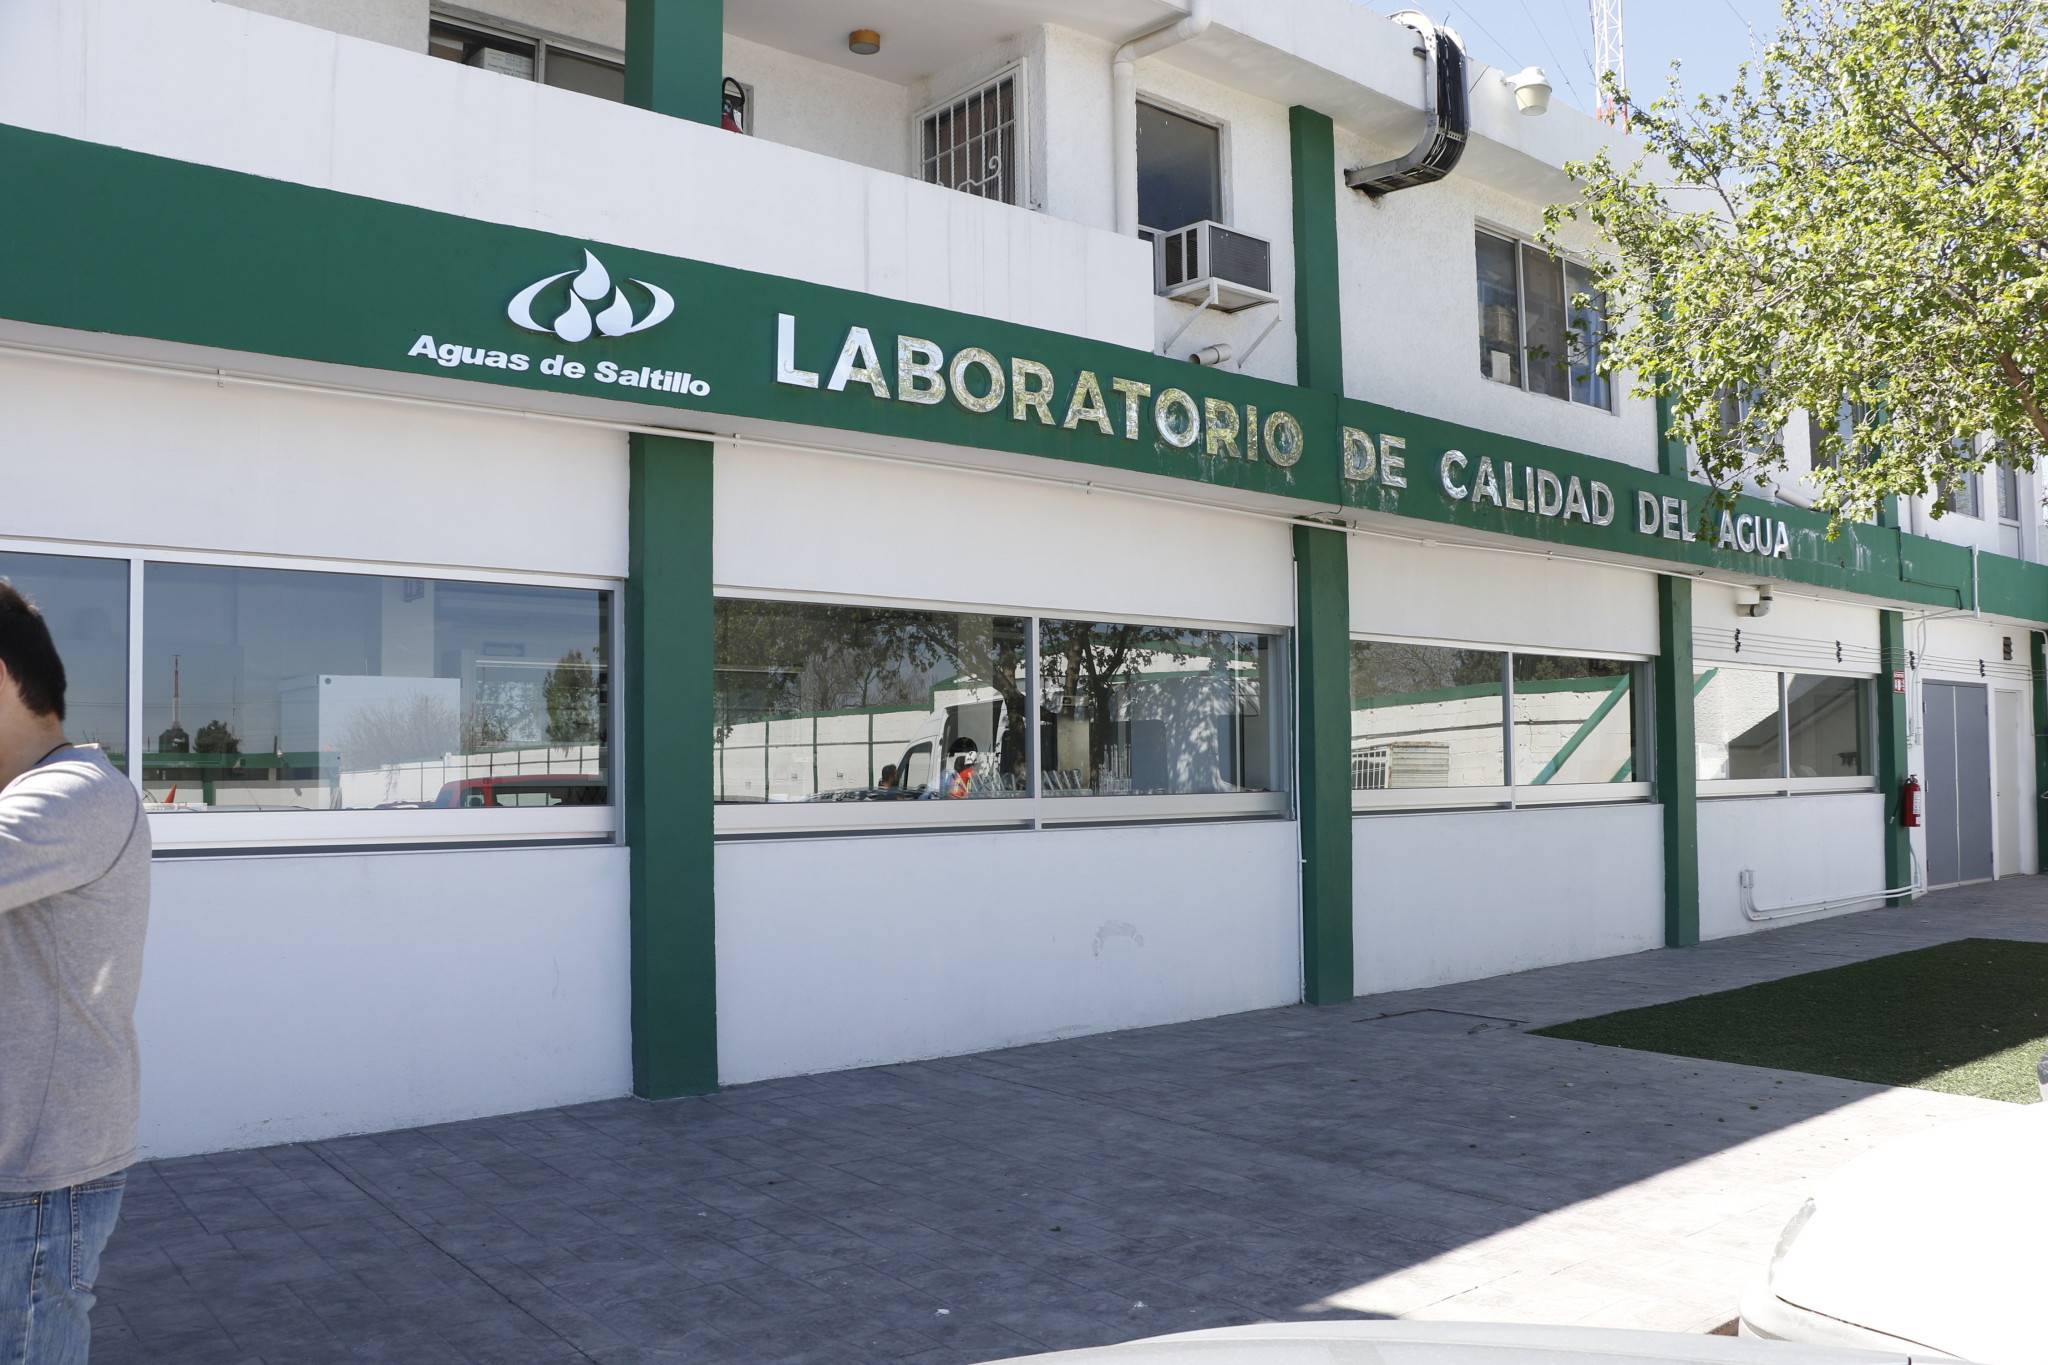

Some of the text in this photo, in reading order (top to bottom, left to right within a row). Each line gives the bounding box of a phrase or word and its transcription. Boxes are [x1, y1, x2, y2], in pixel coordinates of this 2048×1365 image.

[408, 334, 711, 397] Aguas de Saltillo
[776, 312, 1793, 560] LABORATORIO DE CALIDAD DEL AGUA
